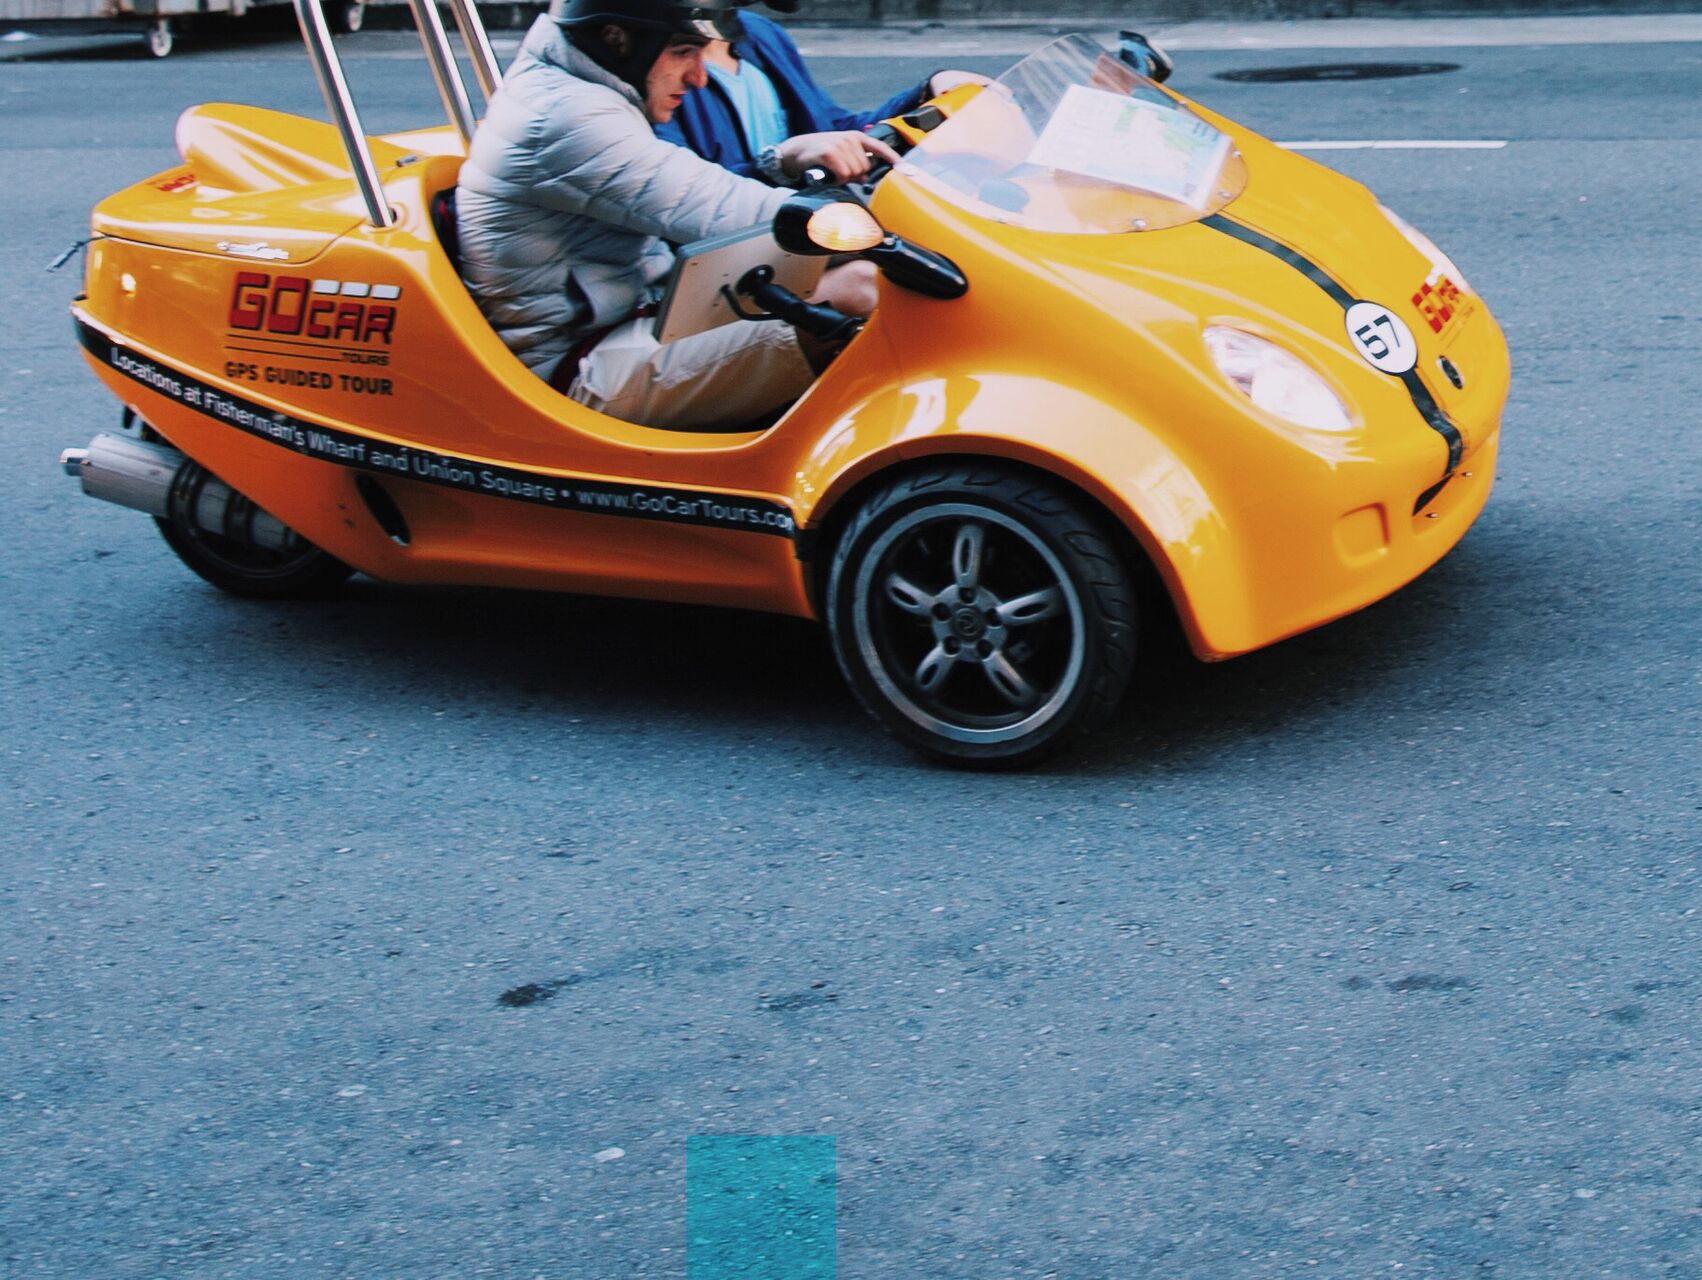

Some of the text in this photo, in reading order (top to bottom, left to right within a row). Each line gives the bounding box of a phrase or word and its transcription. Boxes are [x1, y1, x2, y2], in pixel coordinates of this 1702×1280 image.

[1354, 313, 1401, 360] 57
[224, 360, 394, 396] GPS GUIDED TOUR
[342, 351, 391, 367] TOURS
[110, 346, 182, 396] Locations
[183, 385, 203, 406] at
[204, 391, 305, 447] Fisherman's
[306, 429, 366, 462] Wharf
[370, 447, 409, 472] and
[413, 451, 476, 485] Union
[481, 470, 558, 503] Square
